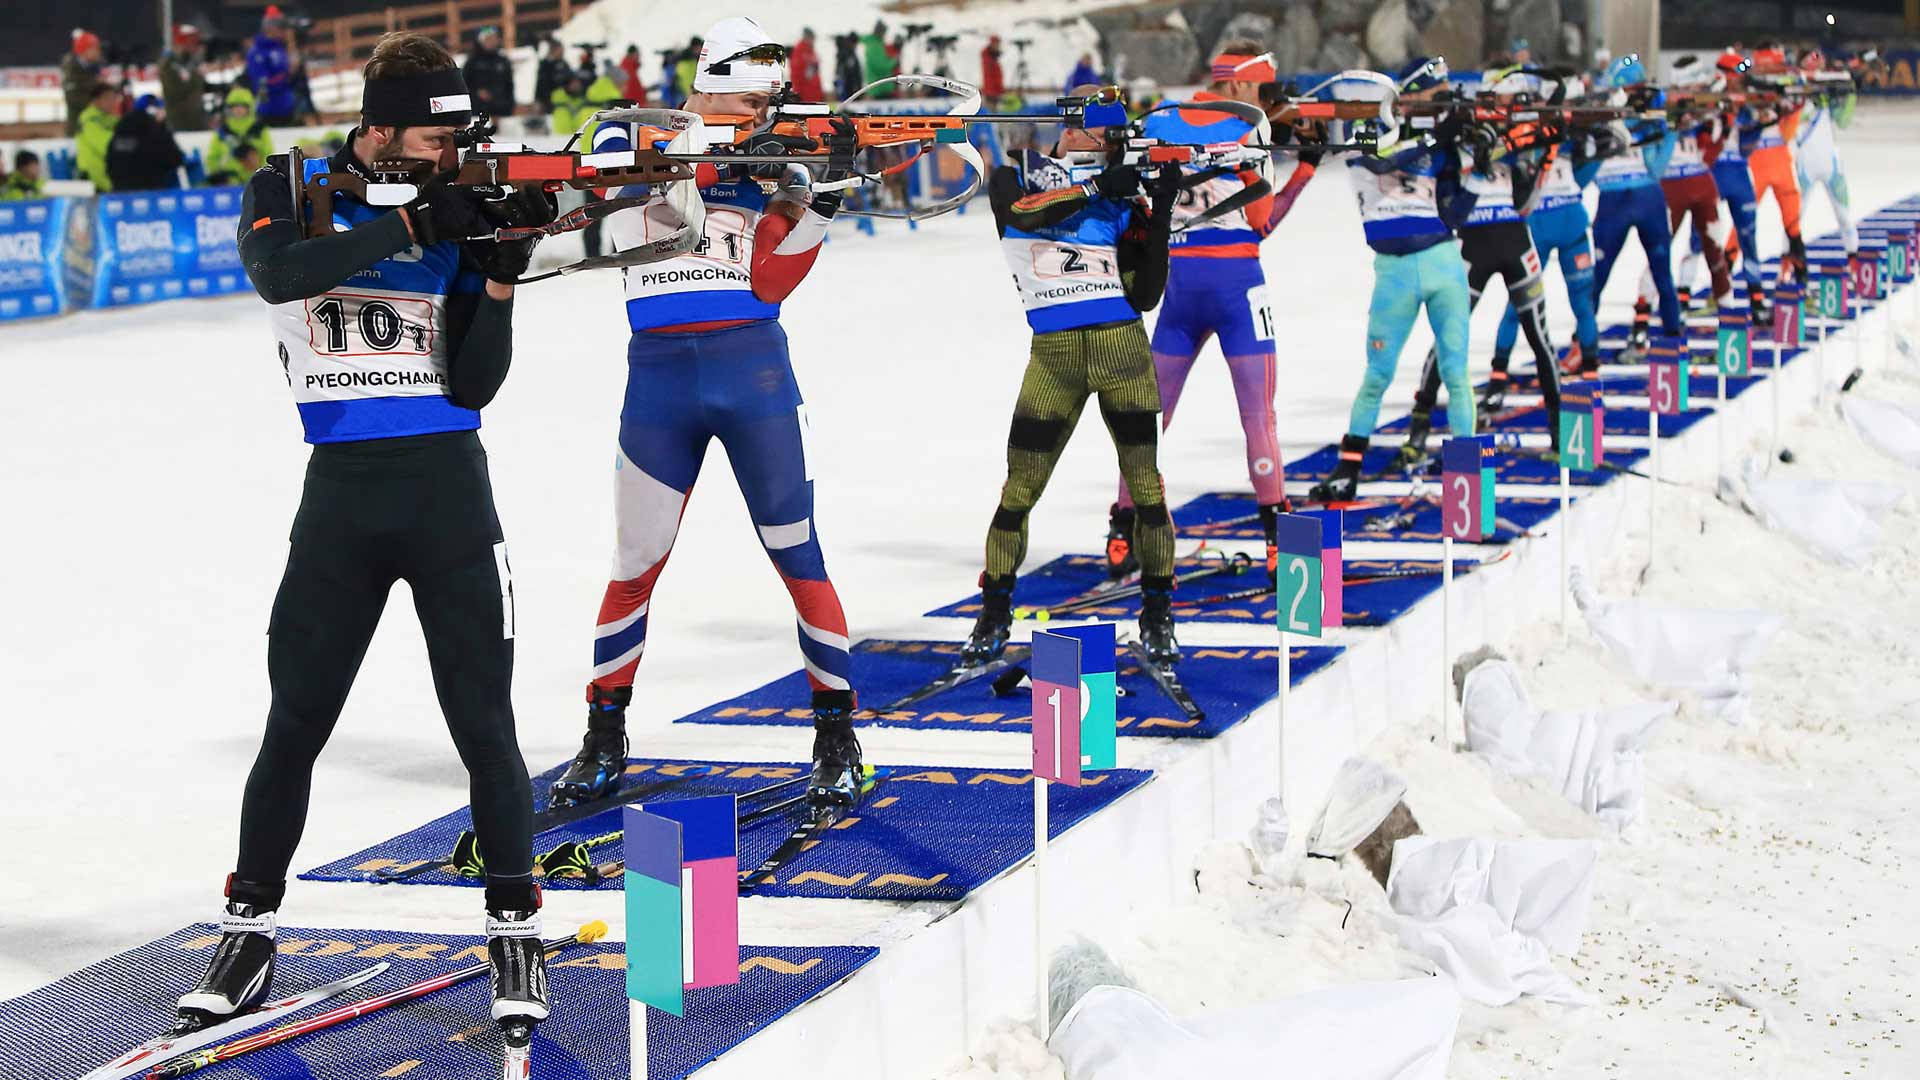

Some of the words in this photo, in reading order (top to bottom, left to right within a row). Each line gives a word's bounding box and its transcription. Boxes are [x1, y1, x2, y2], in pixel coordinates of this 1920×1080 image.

[710, 187, 738, 198] Bank
[720, 232, 741, 260] 1
[1060, 247, 1088, 275] 2
[1890, 244, 1906, 278] 10
[1825, 279, 1837, 316] 8
[1861, 263, 1873, 297] 9
[312, 298, 404, 352] 10
[1781, 304, 1793, 342] 7
[1724, 331, 1740, 375] 6
[305, 371, 446, 389] PYEONGCHANG
[1656, 365, 1672, 413] 5
[1567, 415, 1586, 468] 4
[1452, 476, 1471, 538] 3
[1288, 557, 1310, 632] 2
[1047, 688, 1062, 780] 1
